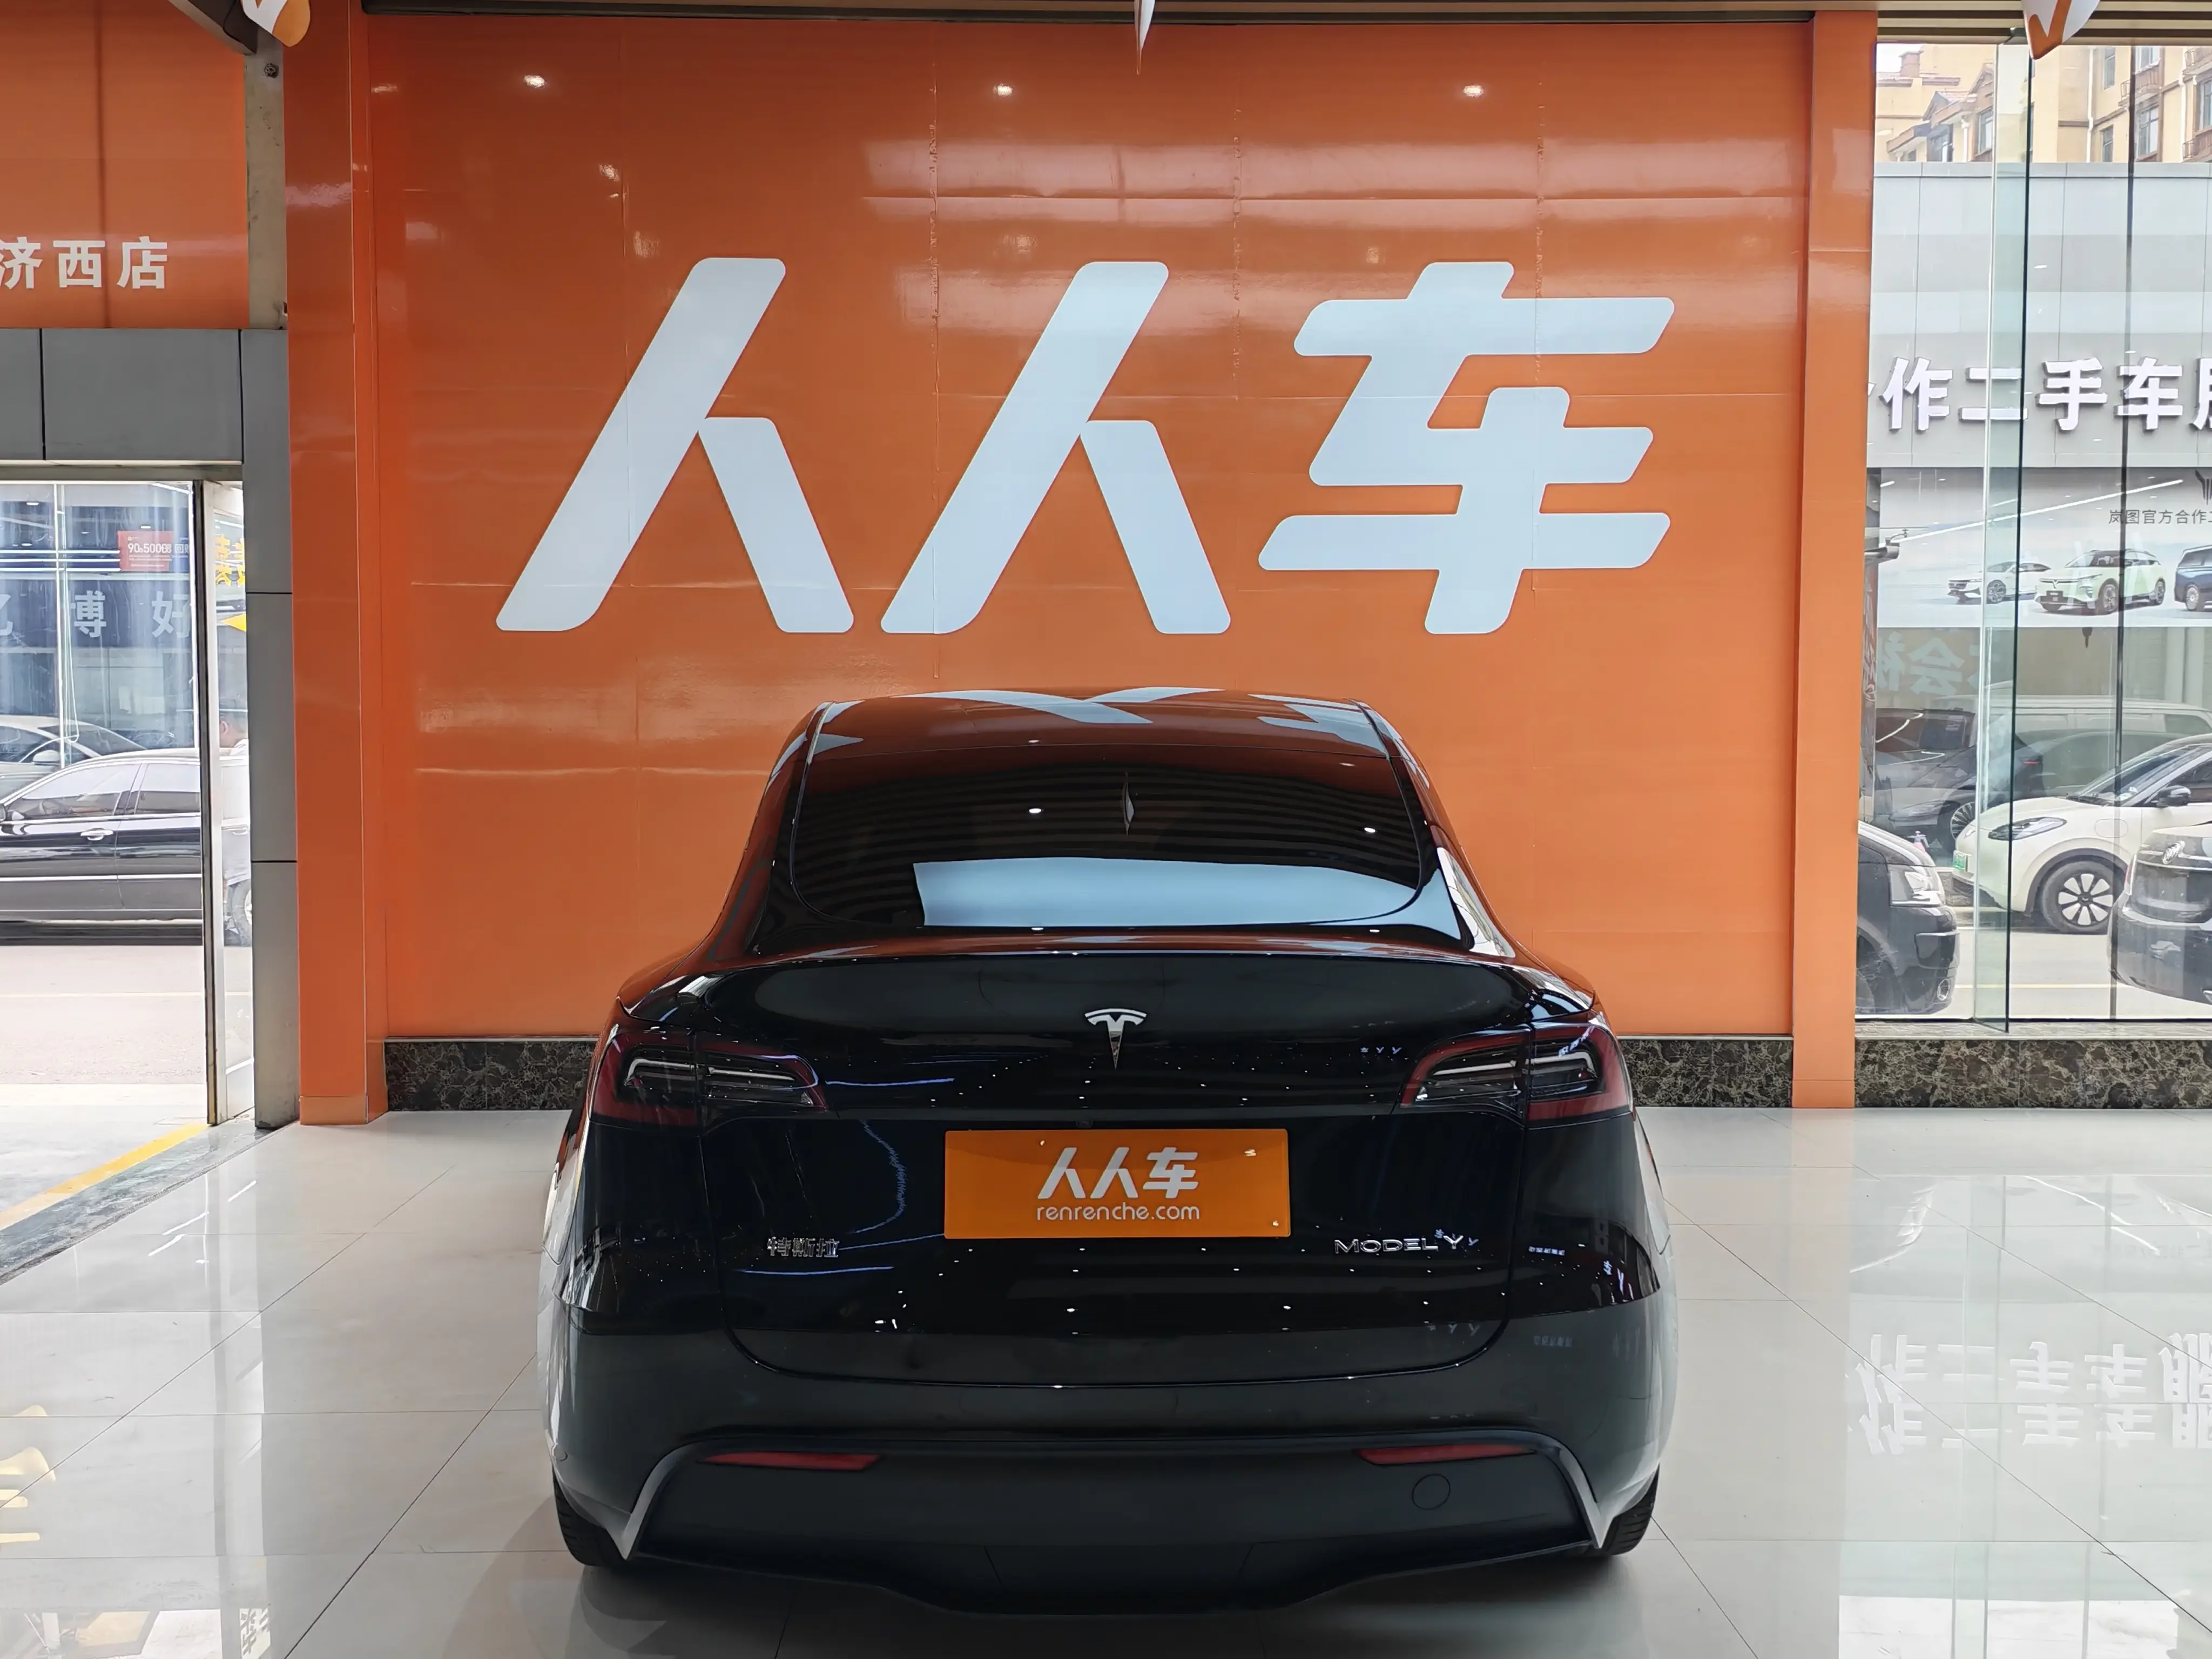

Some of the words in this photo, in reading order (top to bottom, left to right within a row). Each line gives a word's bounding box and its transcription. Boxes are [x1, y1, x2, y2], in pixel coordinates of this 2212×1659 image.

[0, 236, 168, 289] 济西店
[1867, 356, 2212, 431] 作二手车
[496, 257, 1675, 634] 人人车
[2108, 509, 2212, 524] 岚图官方合作
[1037, 1147, 1199, 1199] 人人车
[1037, 1202, 1200, 1220] renrenche.com
[767, 1236, 840, 1258] 特斯拉
[1334, 1238, 1438, 1254] MODEL
[1443, 1235, 1464, 1250] Y
